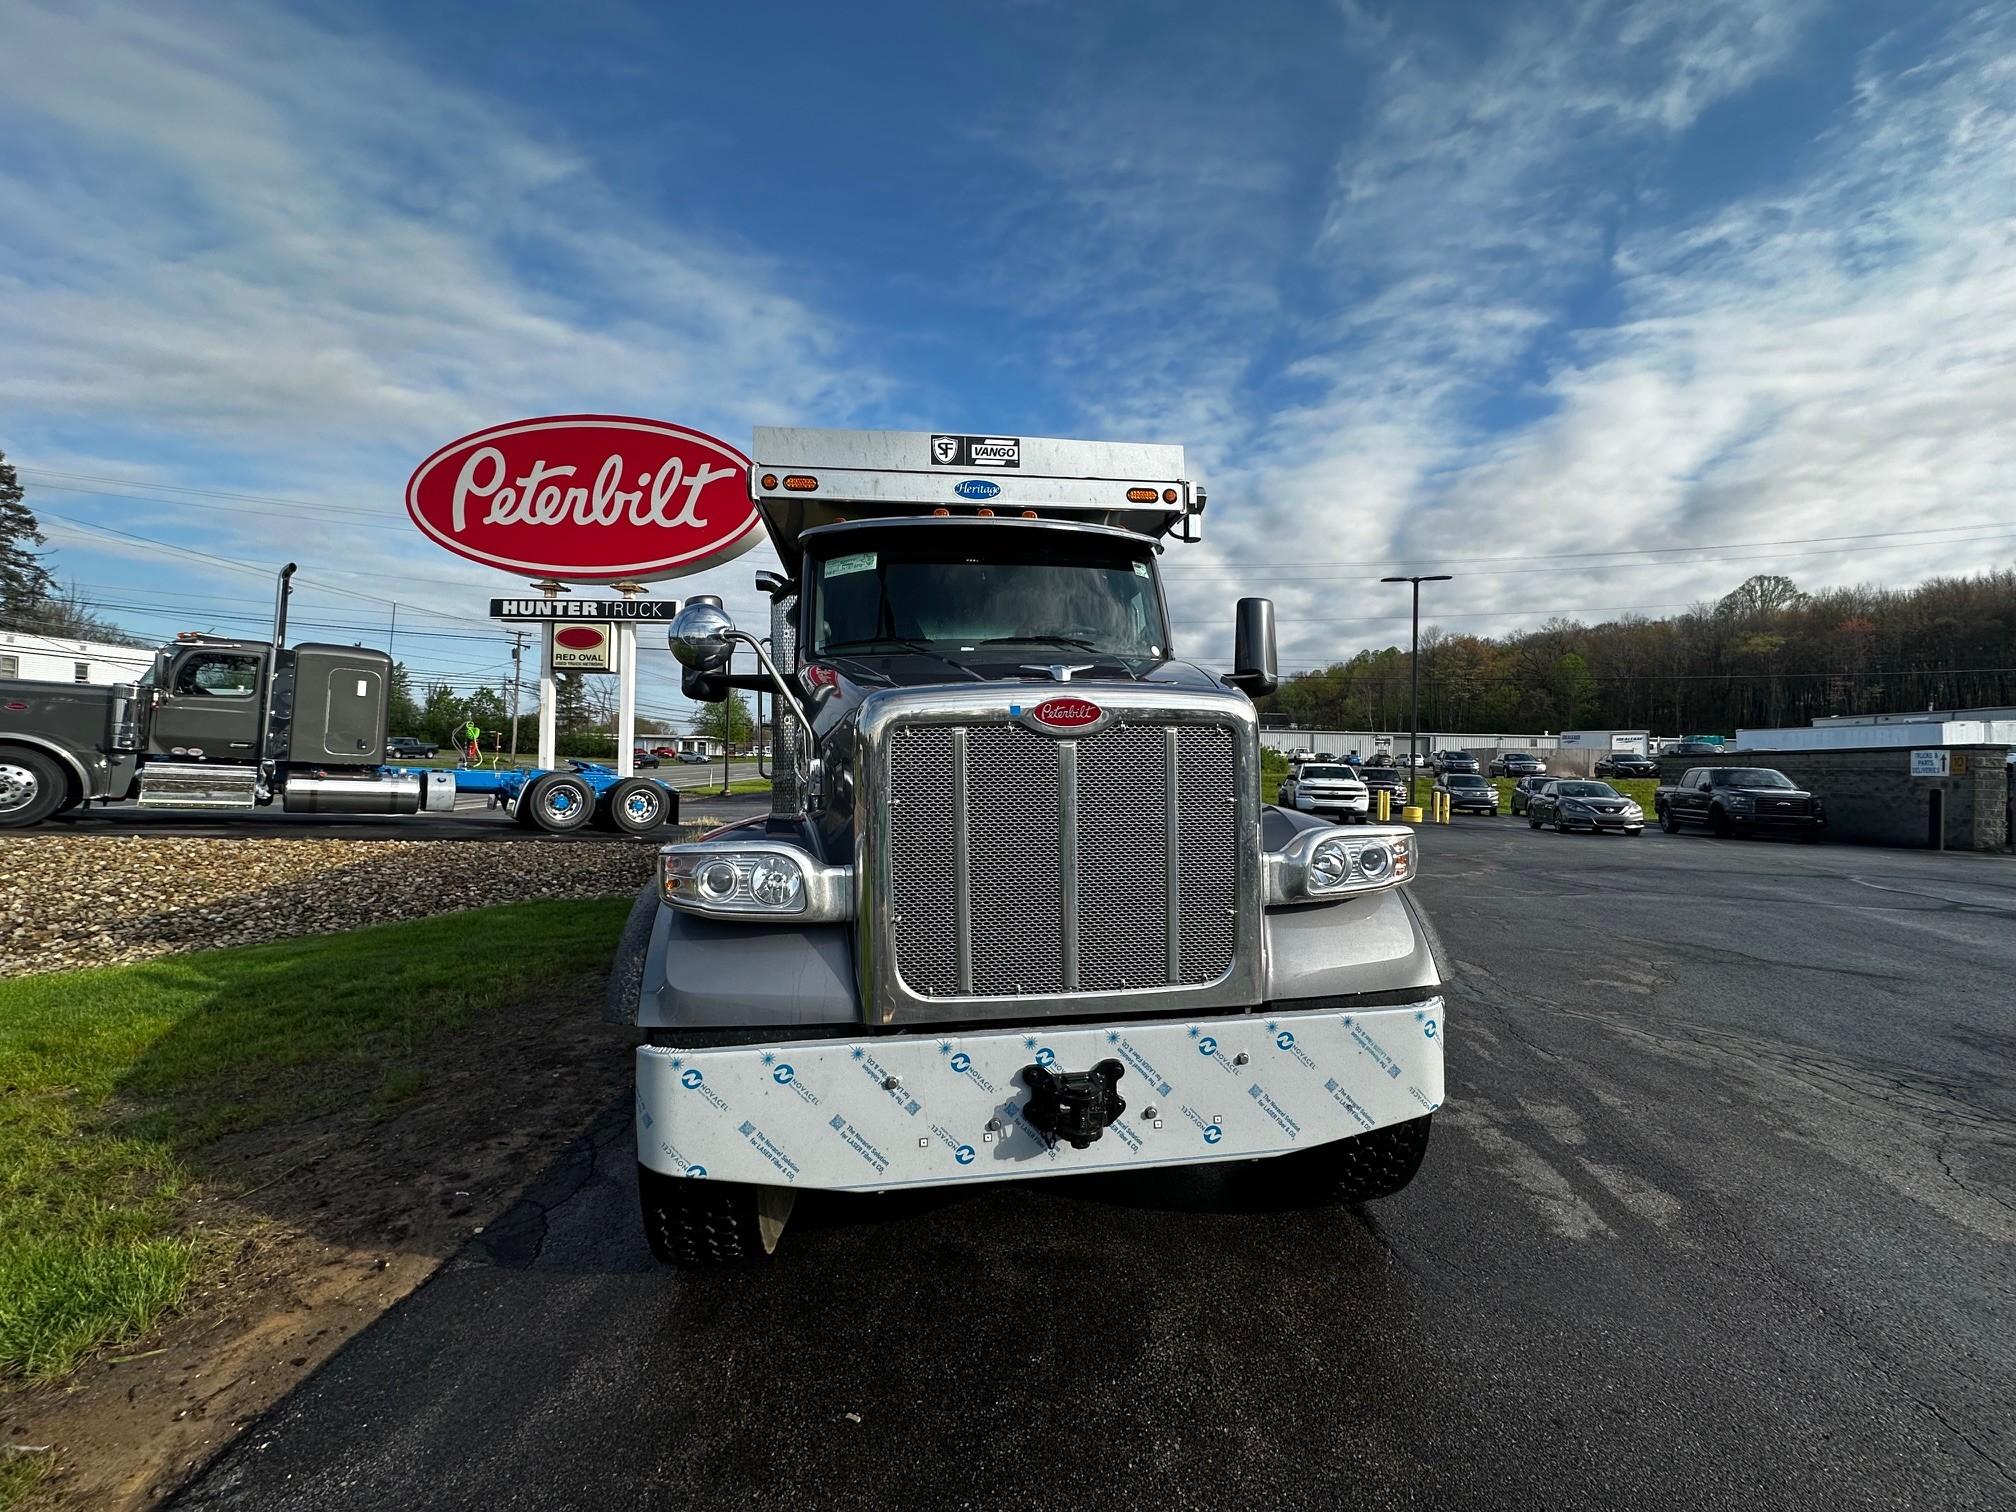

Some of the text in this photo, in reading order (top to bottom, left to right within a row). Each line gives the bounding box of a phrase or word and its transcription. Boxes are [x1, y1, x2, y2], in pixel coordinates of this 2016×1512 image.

[937, 442, 954, 459] SF
[974, 446, 1016, 458] VANGO
[452, 446, 737, 533] Peterbilt
[956, 482, 1000, 496] Heritage
[502, 600, 663, 617] HUNTER TRUCK
[578, 654, 604, 662] OVAL
[1042, 703, 1096, 720] Peterbilt
[1215, 1051, 1240, 1076] NOVACEL
[1293, 1045, 1316, 1071] NOVACEL
[791, 1078, 820, 1106] NOVACEL
[968, 1067, 994, 1094] NOVACEL
[700, 1083, 730, 1112] NOVACEL
[1181, 1105, 1206, 1130] NOVACEL
[931, 1124, 958, 1151] NOVACEL
[661, 1142, 688, 1171] NOVACEL
